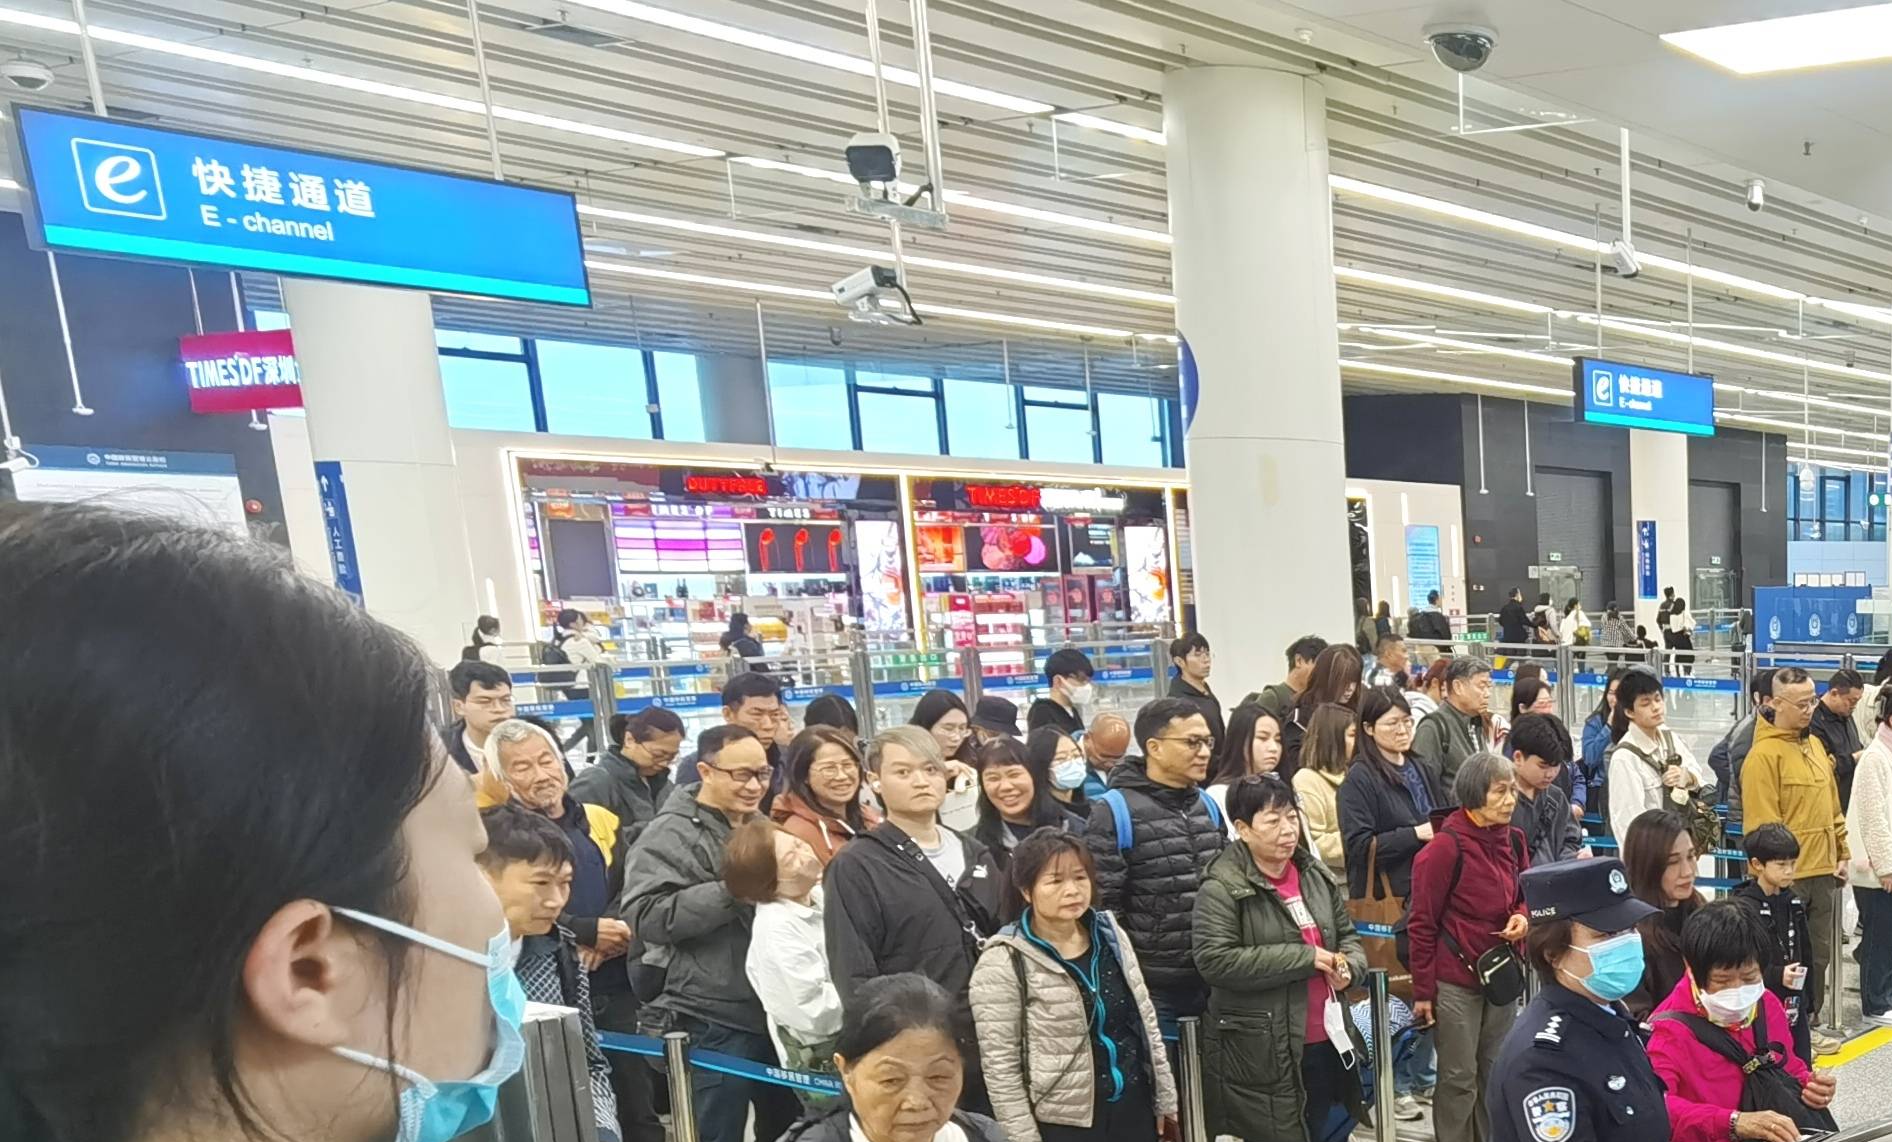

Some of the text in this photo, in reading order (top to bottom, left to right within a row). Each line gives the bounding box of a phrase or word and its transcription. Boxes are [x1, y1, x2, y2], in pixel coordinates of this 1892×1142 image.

[192, 156, 376, 218] 快捷通道
[242, 211, 335, 241] channel
